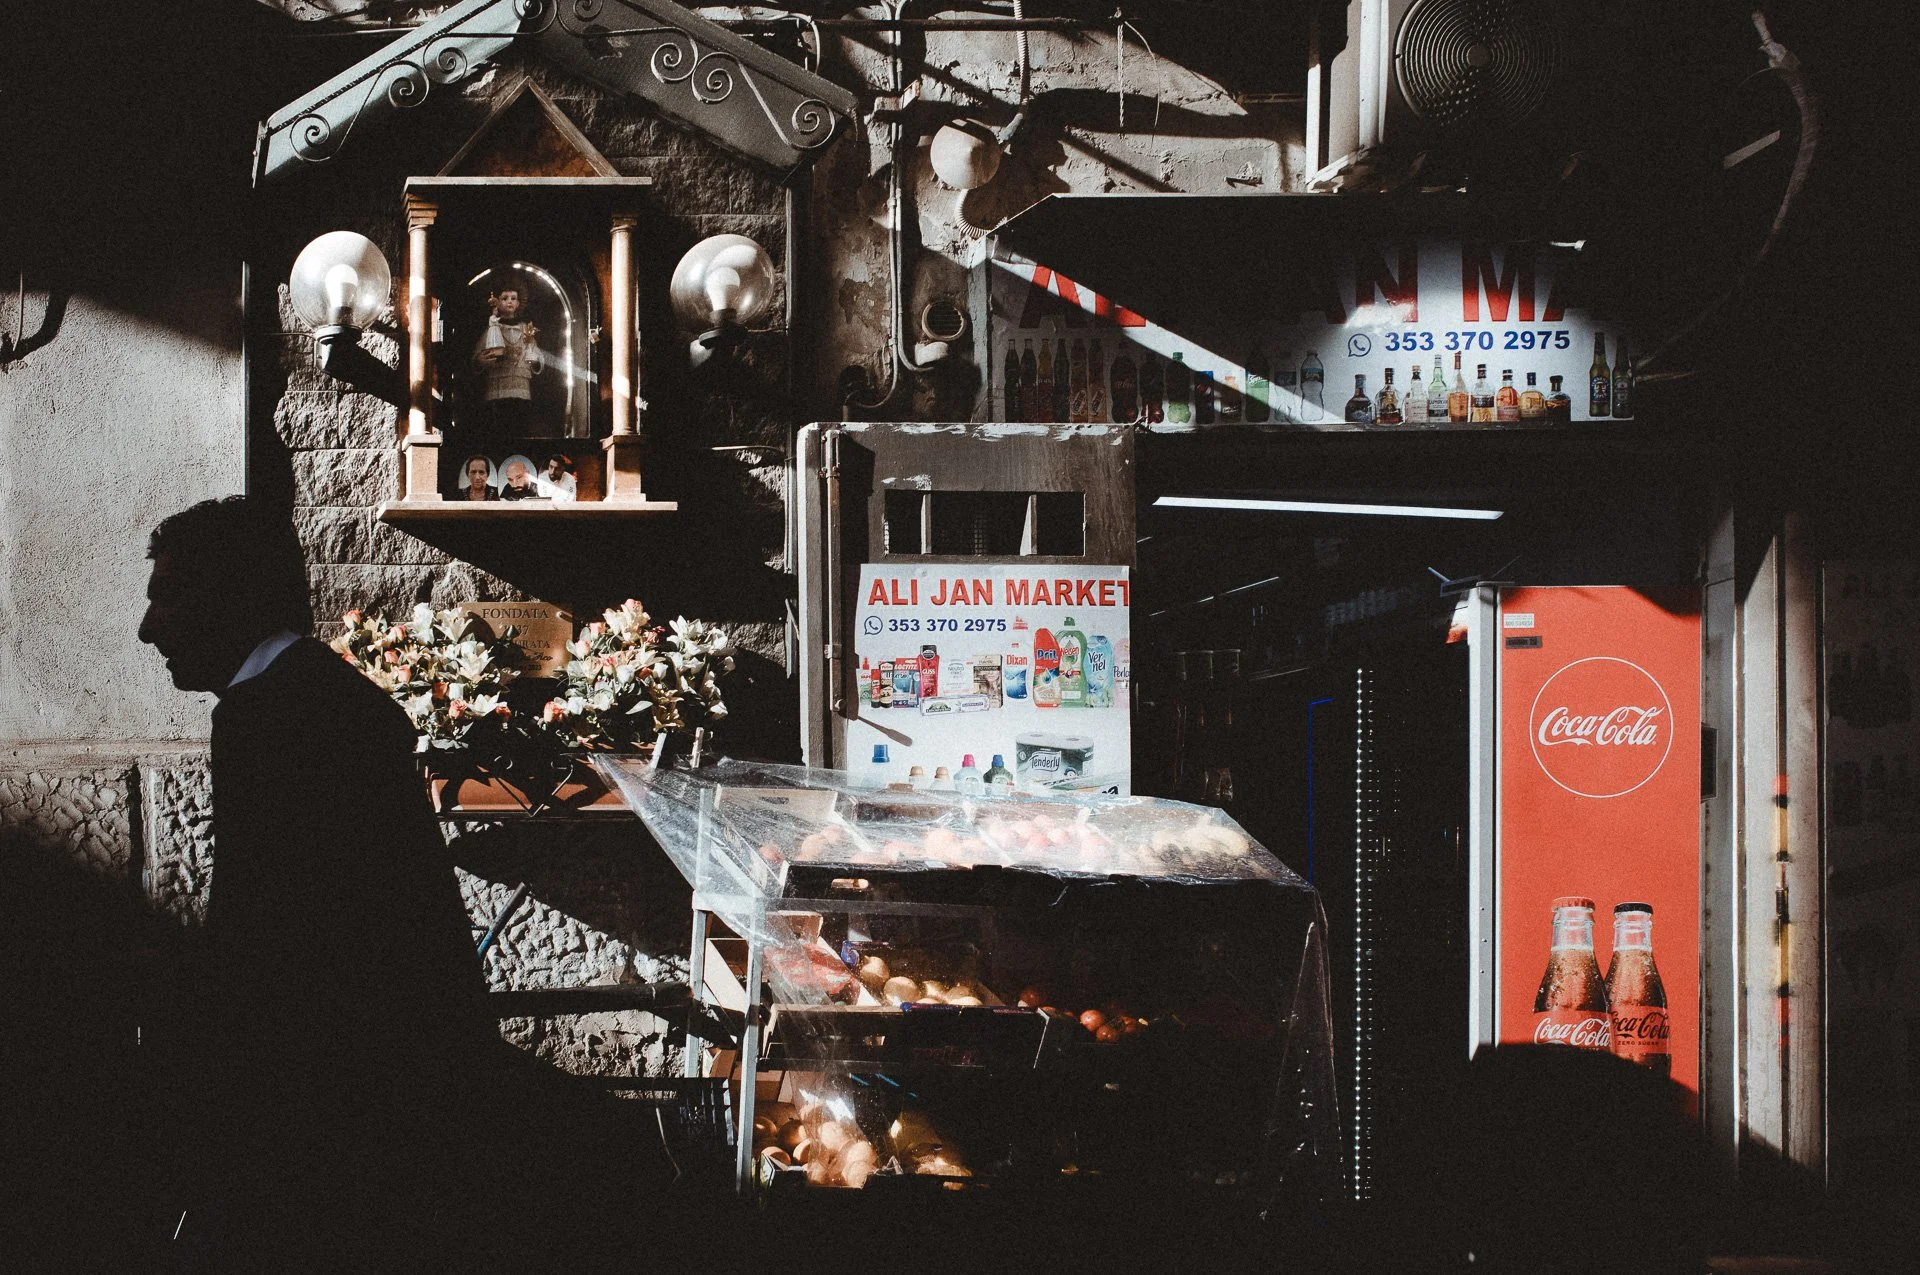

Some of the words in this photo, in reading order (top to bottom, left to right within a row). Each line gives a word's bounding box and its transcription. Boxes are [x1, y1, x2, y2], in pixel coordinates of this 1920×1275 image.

[1385, 331, 1434, 351] 353
[1444, 331, 1494, 350] 370
[1503, 330, 1570, 350] 2975
[868, 579, 918, 605] ALI
[930, 579, 993, 606] JAN
[1006, 579, 1128, 606] MARKET
[482, 608, 549, 619] FONDATA
[888, 619, 920, 631] 353
[926, 619, 958, 631] 370
[964, 619, 1007, 631] 2975
[1006, 654, 1028, 666] Dixan
[1036, 649, 1058, 660] Pril
[1537, 706, 1665, 746] Coca-Cola
[1029, 755, 1061, 772] Tenderly
[1533, 1017, 1610, 1047] Coca-Cola
